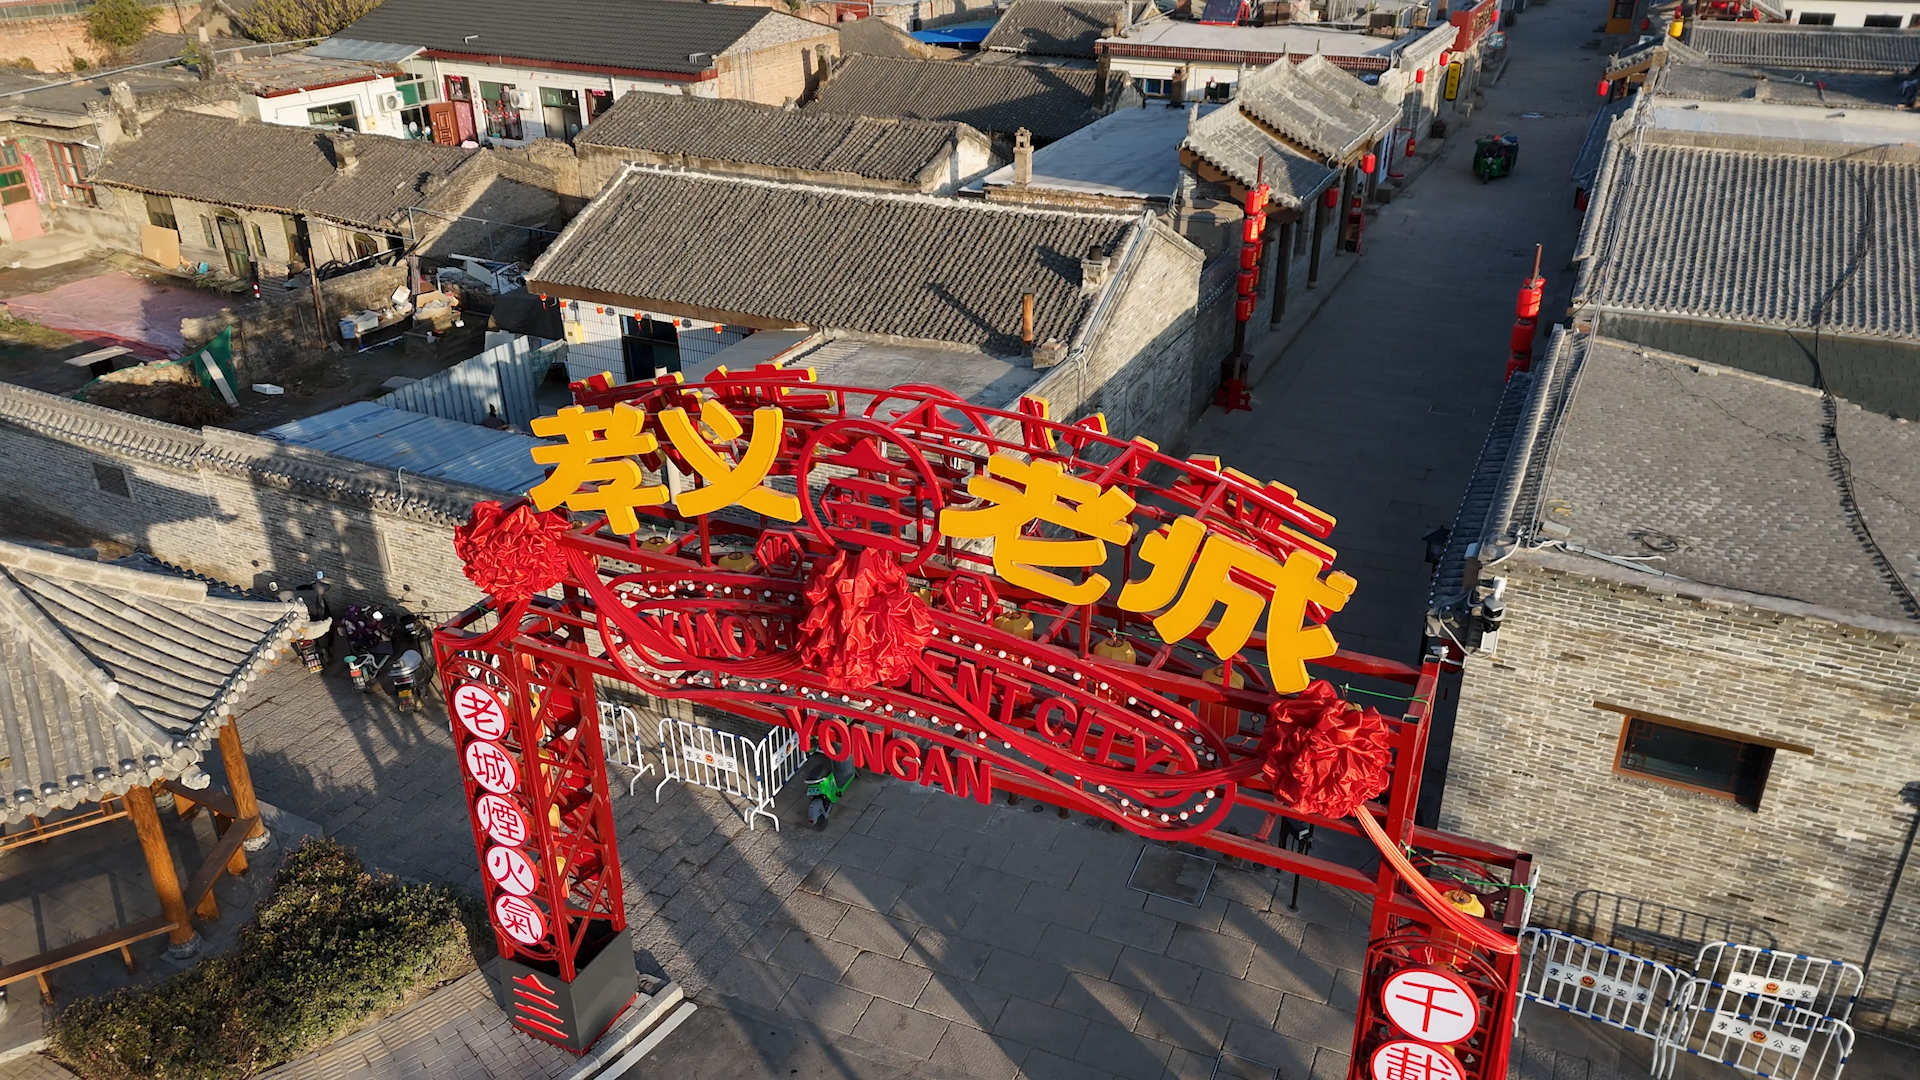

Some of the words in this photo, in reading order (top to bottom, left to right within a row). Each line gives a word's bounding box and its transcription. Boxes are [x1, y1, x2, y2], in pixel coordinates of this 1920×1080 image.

[530, 399, 803, 535] 孝义
[939, 452, 1357, 694] 老城
[785, 705, 993, 806] YONGAN
[1035, 695, 1174, 774] CITY
[718, 759, 734, 770] 公安
[460, 691, 540, 945] 老城煙火氣
[1549, 967, 1575, 982] 孝义
[1601, 983, 1627, 998] 公安
[1732, 978, 1758, 990] 孝义
[1785, 988, 1812, 999] 公安
[1717, 1021, 1744, 1037] 孝义
[1773, 1039, 1801, 1055] 公安
